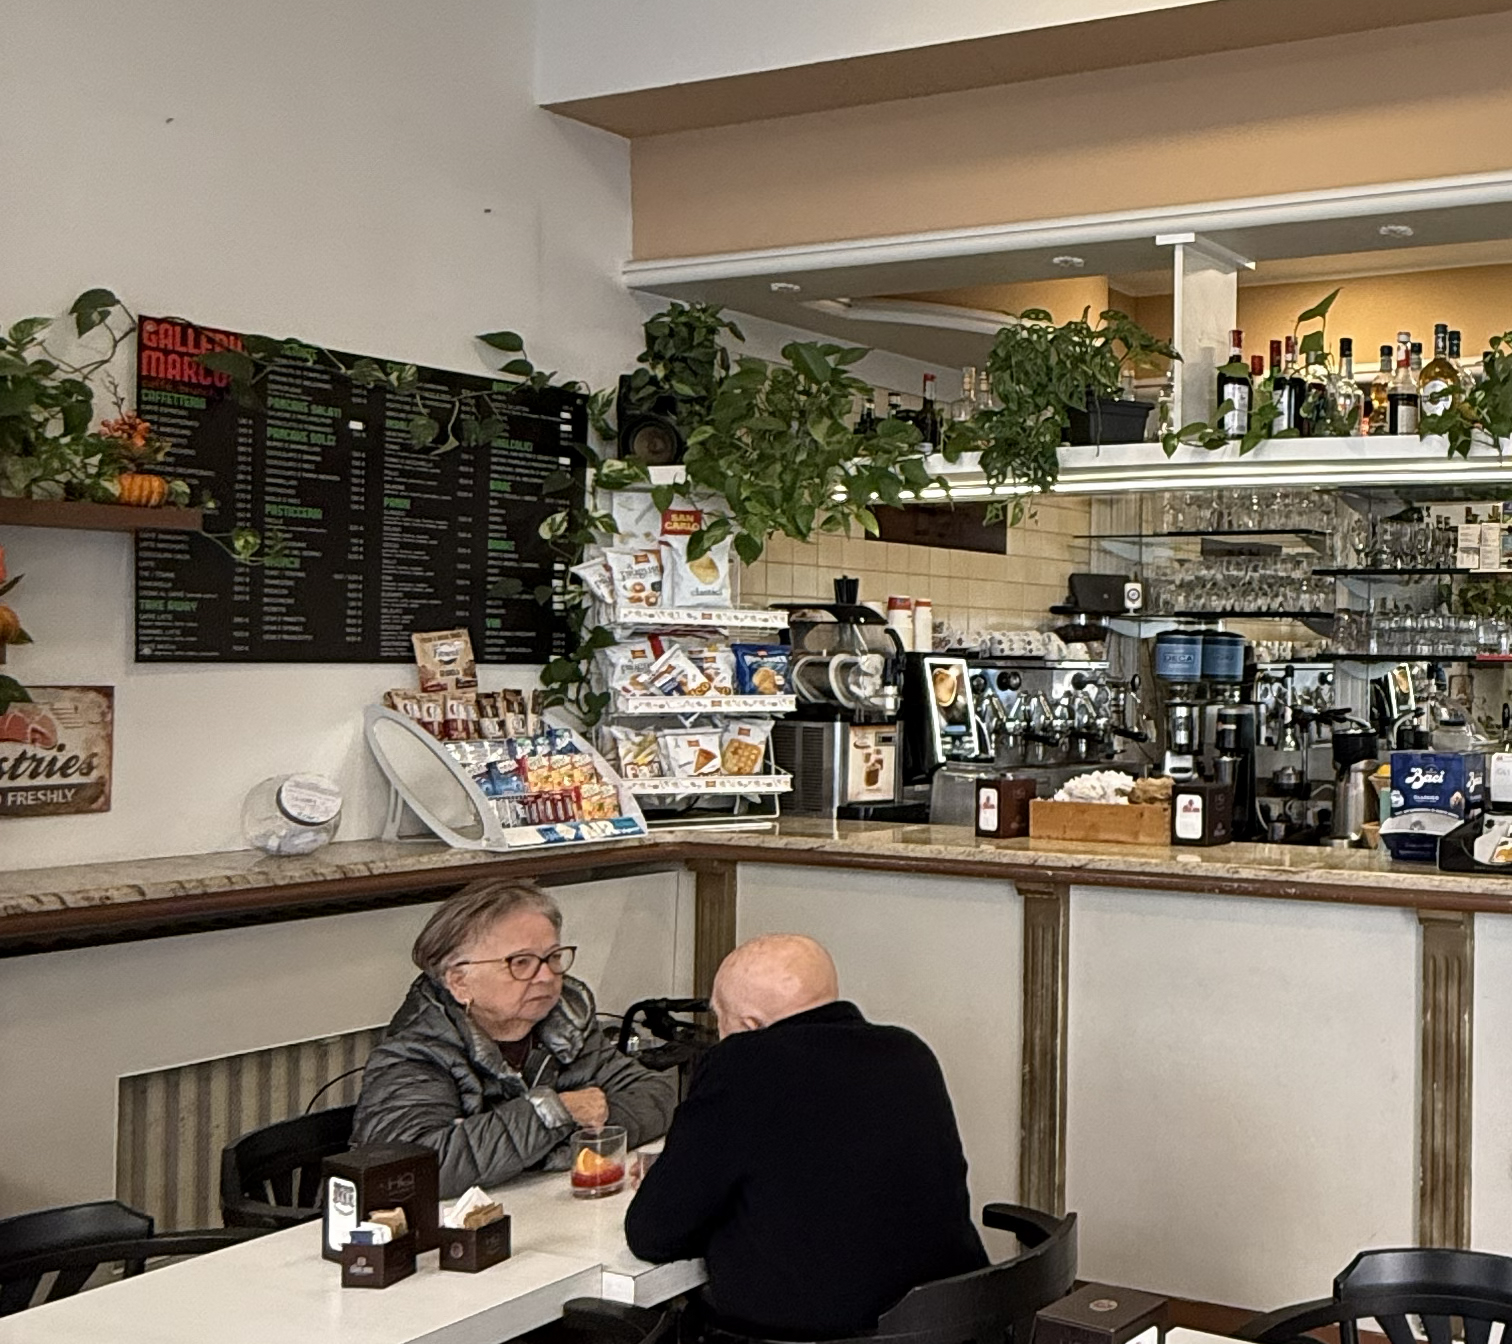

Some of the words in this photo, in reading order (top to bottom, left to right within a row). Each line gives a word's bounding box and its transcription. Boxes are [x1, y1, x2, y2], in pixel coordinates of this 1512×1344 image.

[670, 514, 694, 522] SAN
[664, 522, 700, 530] CARLO
[1165, 654, 1194, 663] DECA
[1405, 767, 1446, 790] Baci
[8, 787, 76, 806] FRESHLY
